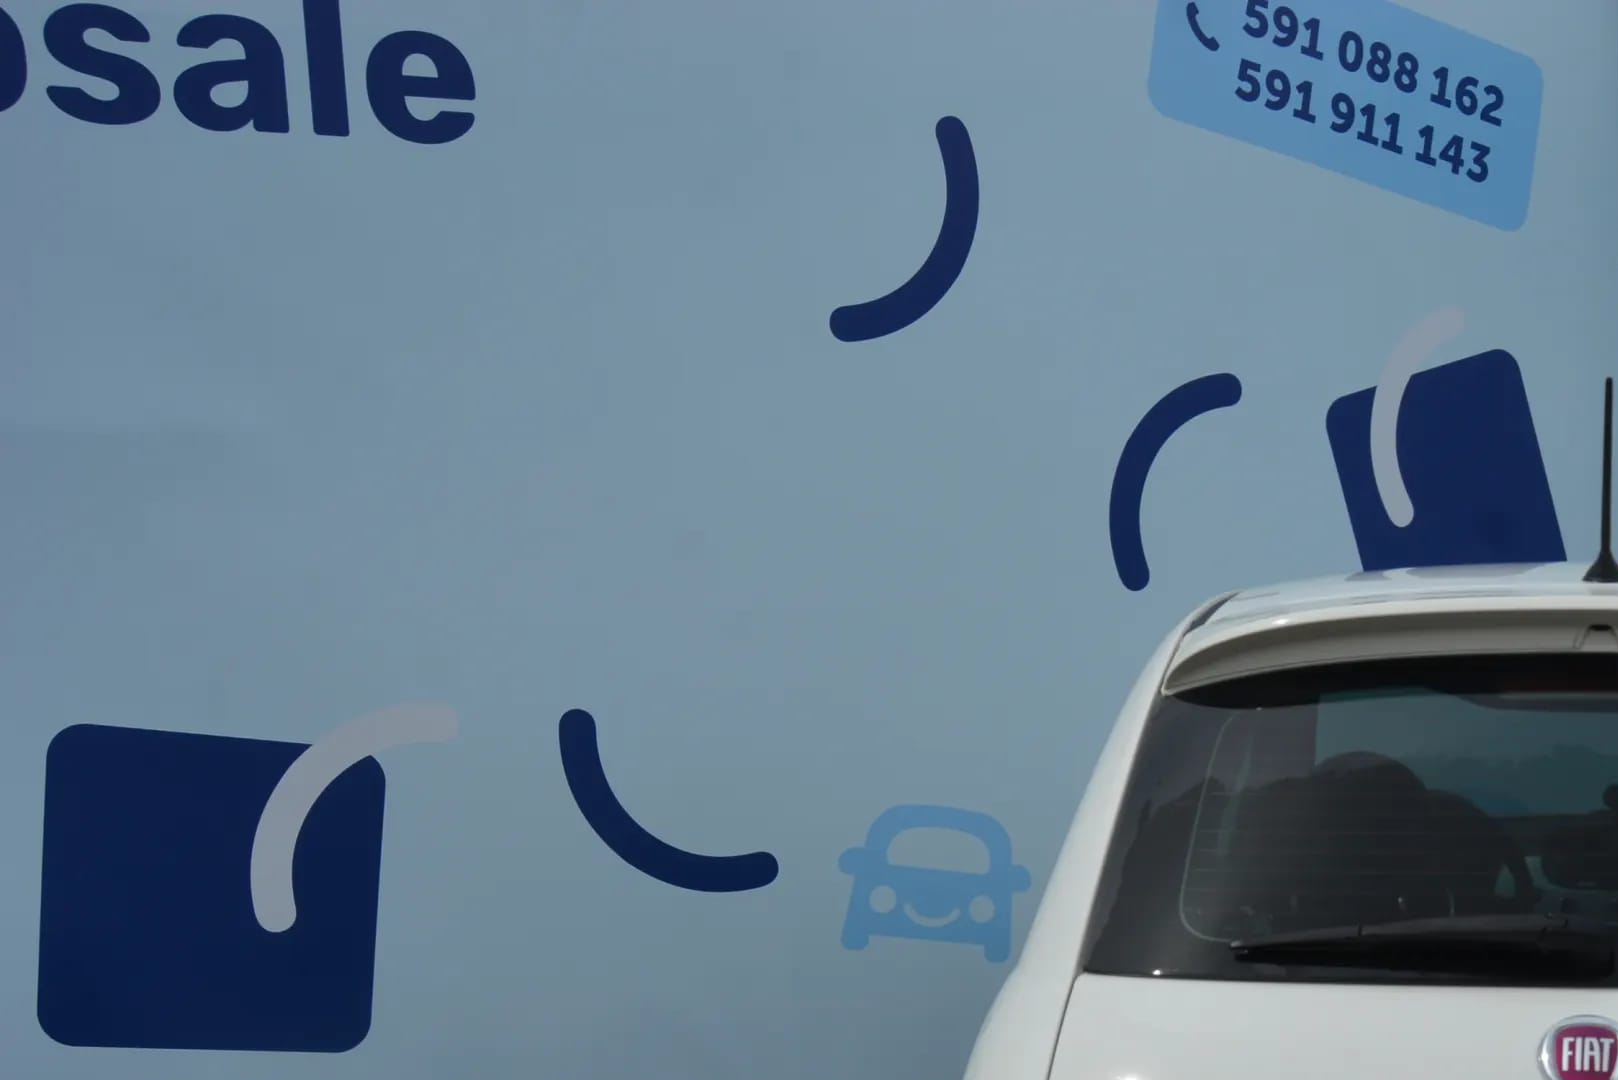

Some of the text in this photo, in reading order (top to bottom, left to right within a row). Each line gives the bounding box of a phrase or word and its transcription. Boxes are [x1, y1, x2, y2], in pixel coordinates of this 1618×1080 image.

[0, 0, 477, 145] sale
[1234, 57, 1491, 184] 591 911 143
[1242, 0, 1505, 128] 591 088 162
[1561, 1036, 1614, 1073] FIAT
